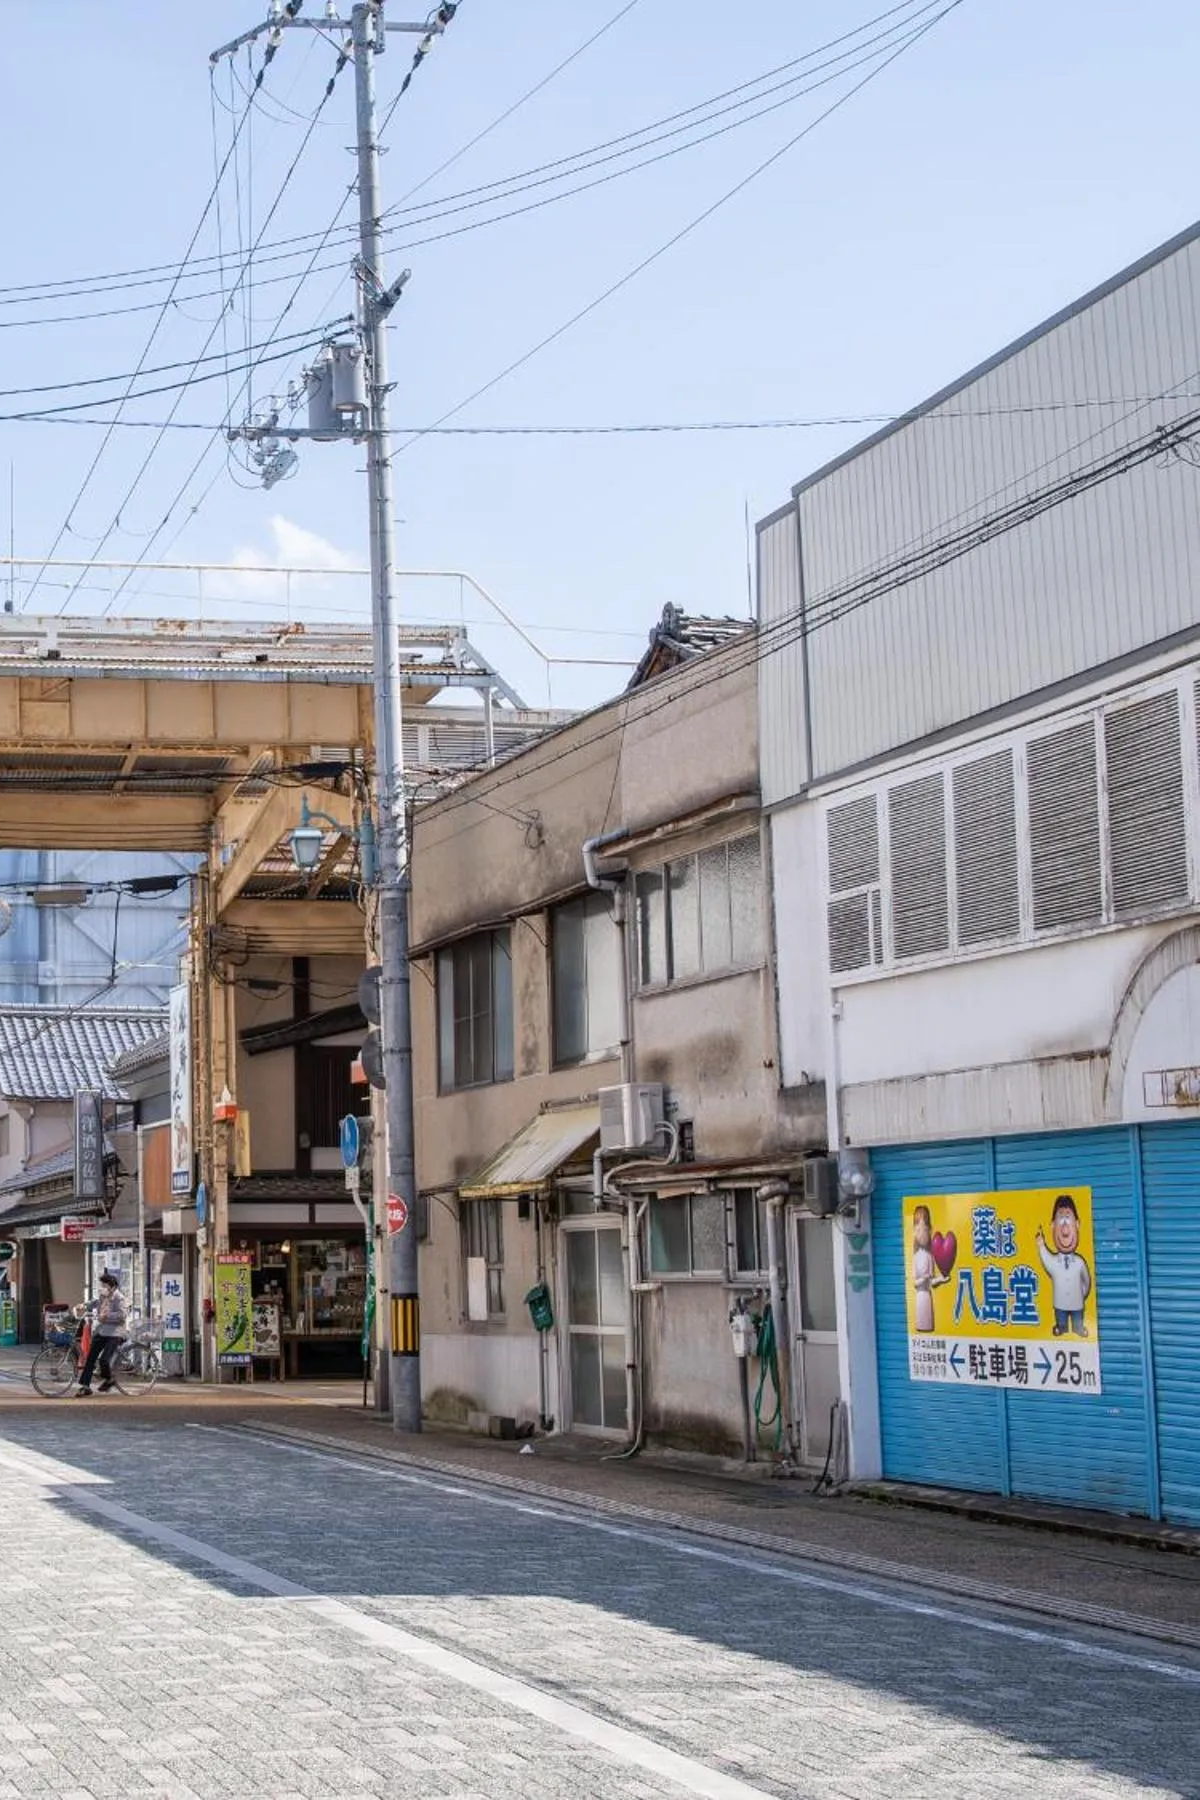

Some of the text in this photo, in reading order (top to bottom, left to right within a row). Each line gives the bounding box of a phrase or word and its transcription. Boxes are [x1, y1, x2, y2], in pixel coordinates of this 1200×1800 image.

[973, 1206, 1017, 1257] 薬は
[165, 1280, 181, 1330] 地酒
[953, 1266, 1040, 1326] 八島堂
[969, 1344, 1097, 1387] 駐車場 25m
